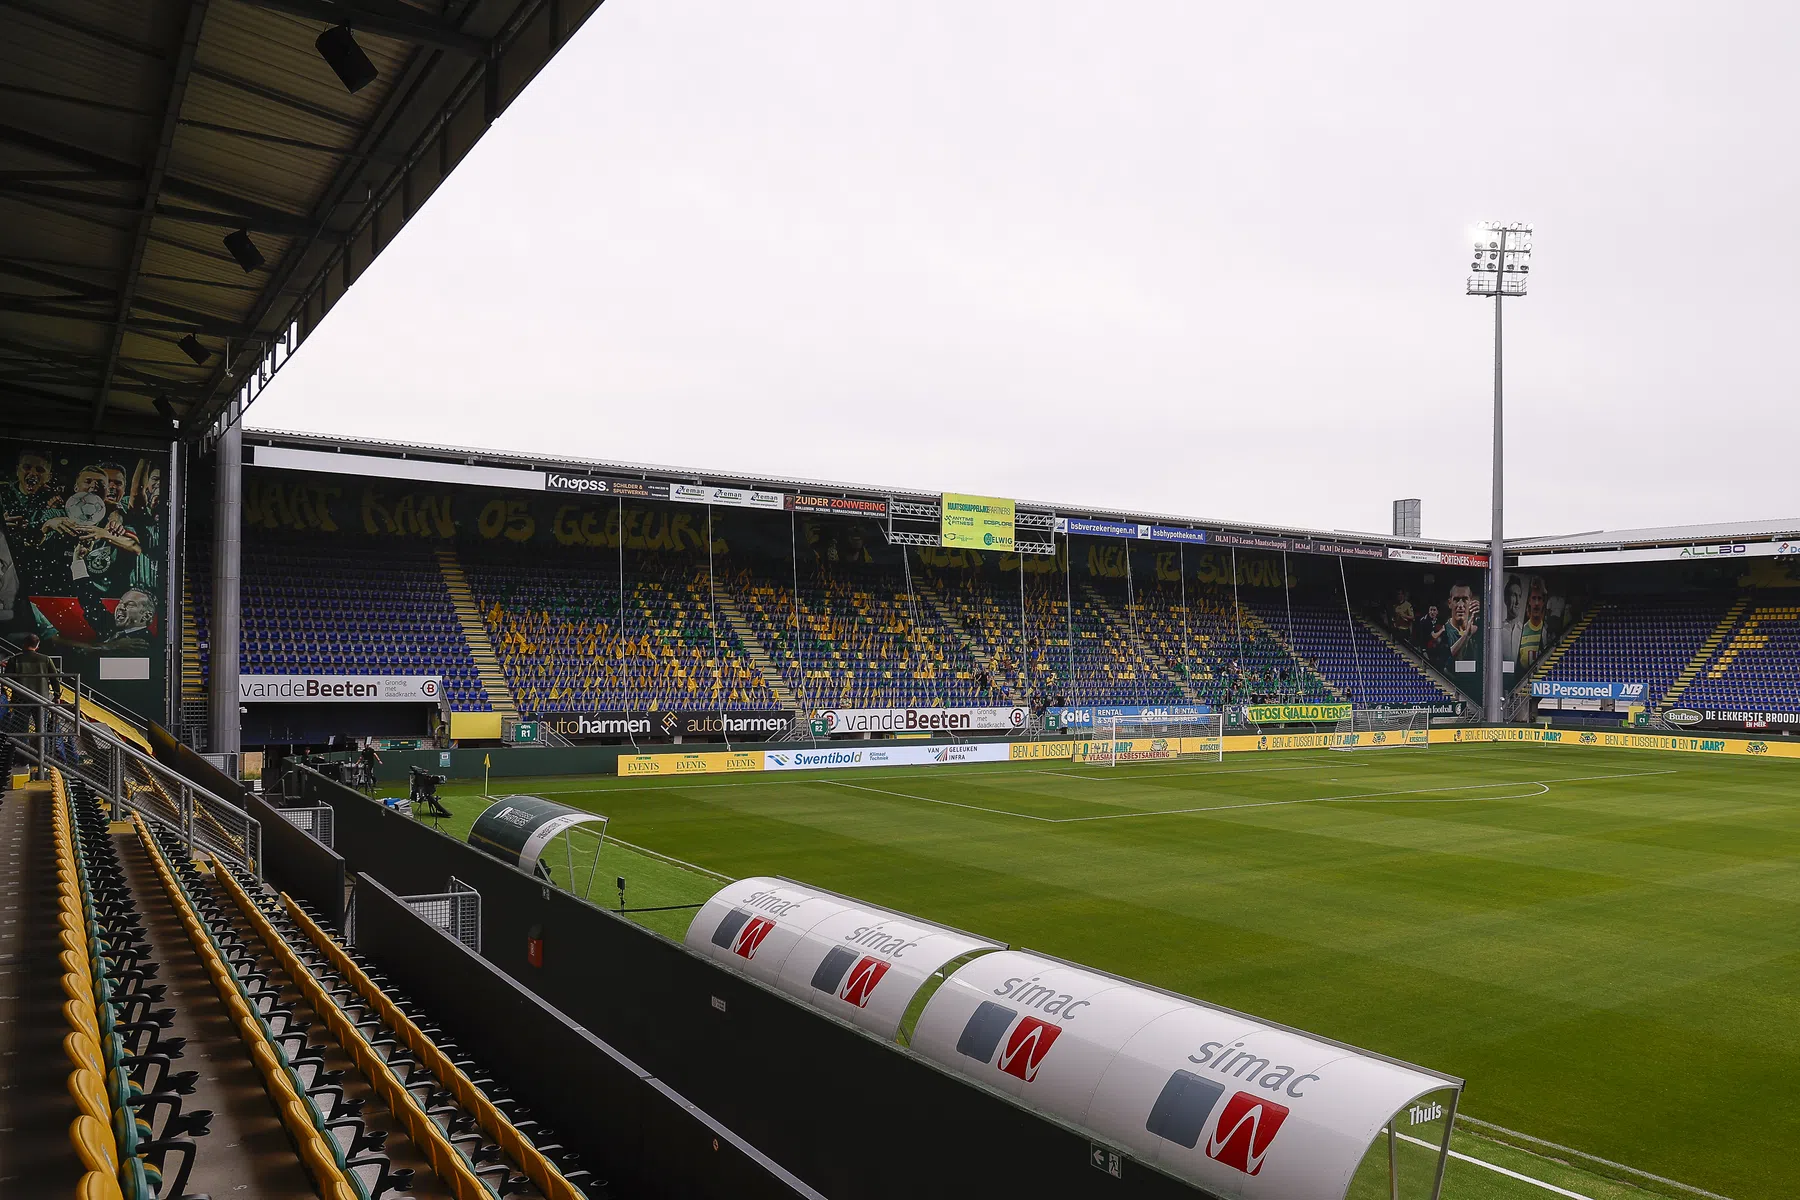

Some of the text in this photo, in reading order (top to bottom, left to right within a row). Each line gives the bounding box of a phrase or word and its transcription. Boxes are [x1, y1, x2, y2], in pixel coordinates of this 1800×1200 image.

[796, 496, 885, 512] ZUIDER ZONWERING
[361, 484, 456, 538] KAN
[553, 505, 730, 554] GEBEURE
[1070, 522, 1136, 535] bsbverzekeringen.nl
[1153, 528, 1203, 541] bsbhypotheken.nl
[1255, 539, 1287, 549] Maatschappij
[1680, 545, 1745, 556] ALLBO
[241, 680, 378, 697] vandeBeeten
[384, 680, 407, 688] Grondig
[1533, 682, 1612, 696] NB Personeel
[1620, 684, 1643, 694] NB
[1061, 709, 1090, 724] Collé
[1249, 708, 1280, 720] TIFOSI
[1283, 706, 1318, 719] GIALLO
[1669, 712, 1698, 720] Bufkes
[1706, 711, 1800, 723] DE LEKKERSTE BROODJ
[688, 714, 786, 732] autoharmen
[846, 710, 970, 731] vandeBeeten
[1273, 737, 1283, 748] BEN
[1285, 737, 1291, 747] JE
[1294, 736, 1314, 747] TUSSEN
[1316, 736, 1322, 746] DE
[1465, 730, 1474, 741] BEN
[1475, 730, 1480, 740] JE
[1481, 730, 1506, 740] TUSSEN
[1508, 730, 1516, 740] DE
[1525, 730, 1532, 740] EN
[1534, 731, 1540, 740] 17
[1542, 732, 1561, 742] JAAR?
[1605, 735, 1725, 751] BEN JE TUSSEN DE 0 EN 17 JAAR?
[1013, 746, 1028, 758] BEN
[1030, 745, 1038, 757] JE
[1042, 744, 1070, 756] TUSSEN
[1073, 744, 1080, 754] DE
[1111, 742, 1133, 753] AAR?
[1119, 751, 1169, 759] ASBESTSANERING
[676, 761, 706, 769] EVENTS
[726, 759, 755, 767] EVENTS
[794, 752, 862, 765] Swentibold
[628, 762, 659, 771] EVENTS
[743, 890, 800, 918] simac
[845, 925, 918, 958] simac
[994, 976, 1091, 1021] simac
[1187, 1040, 1320, 1098] simac
[1409, 1101, 1442, 1126] Thuis
